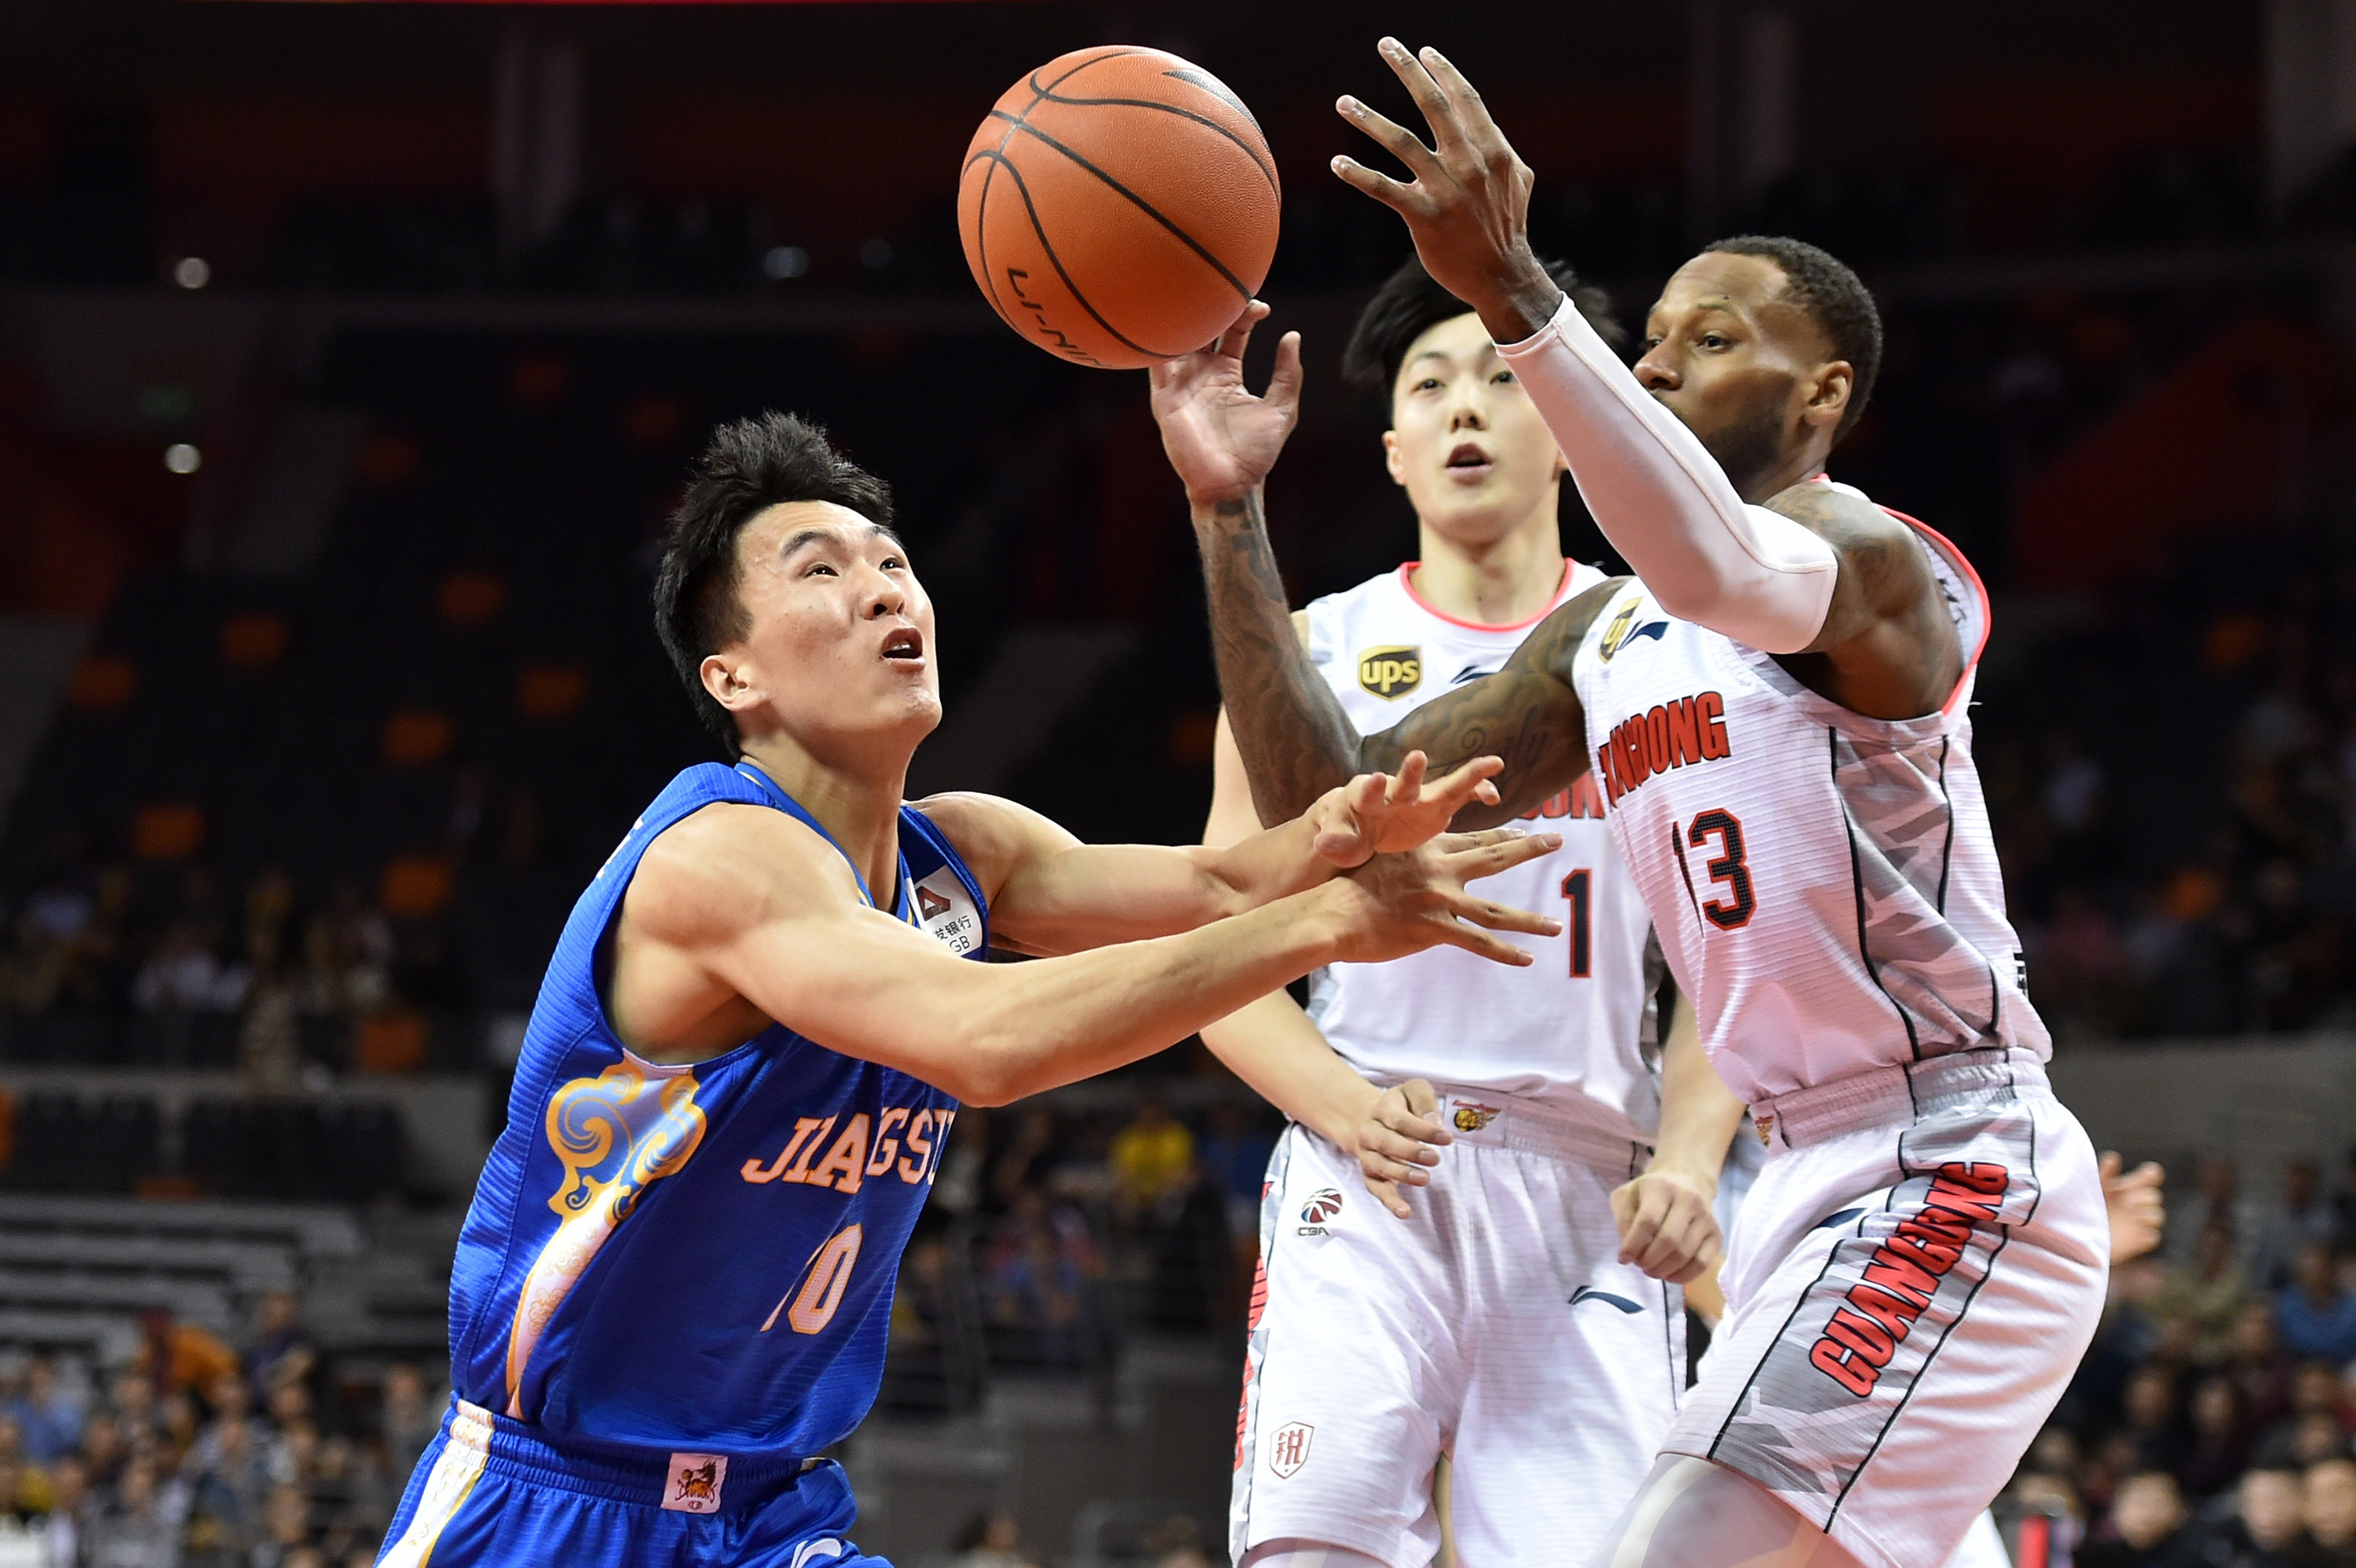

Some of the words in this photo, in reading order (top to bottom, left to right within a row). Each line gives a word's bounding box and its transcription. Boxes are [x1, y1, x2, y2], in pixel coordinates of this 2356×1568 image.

[1361, 660, 1419, 693] ups
[932, 915, 972, 941] 发银行
[1561, 868, 1593, 979] 1
[949, 935, 971, 953] GB
[1297, 1226, 1330, 1237] CBA
